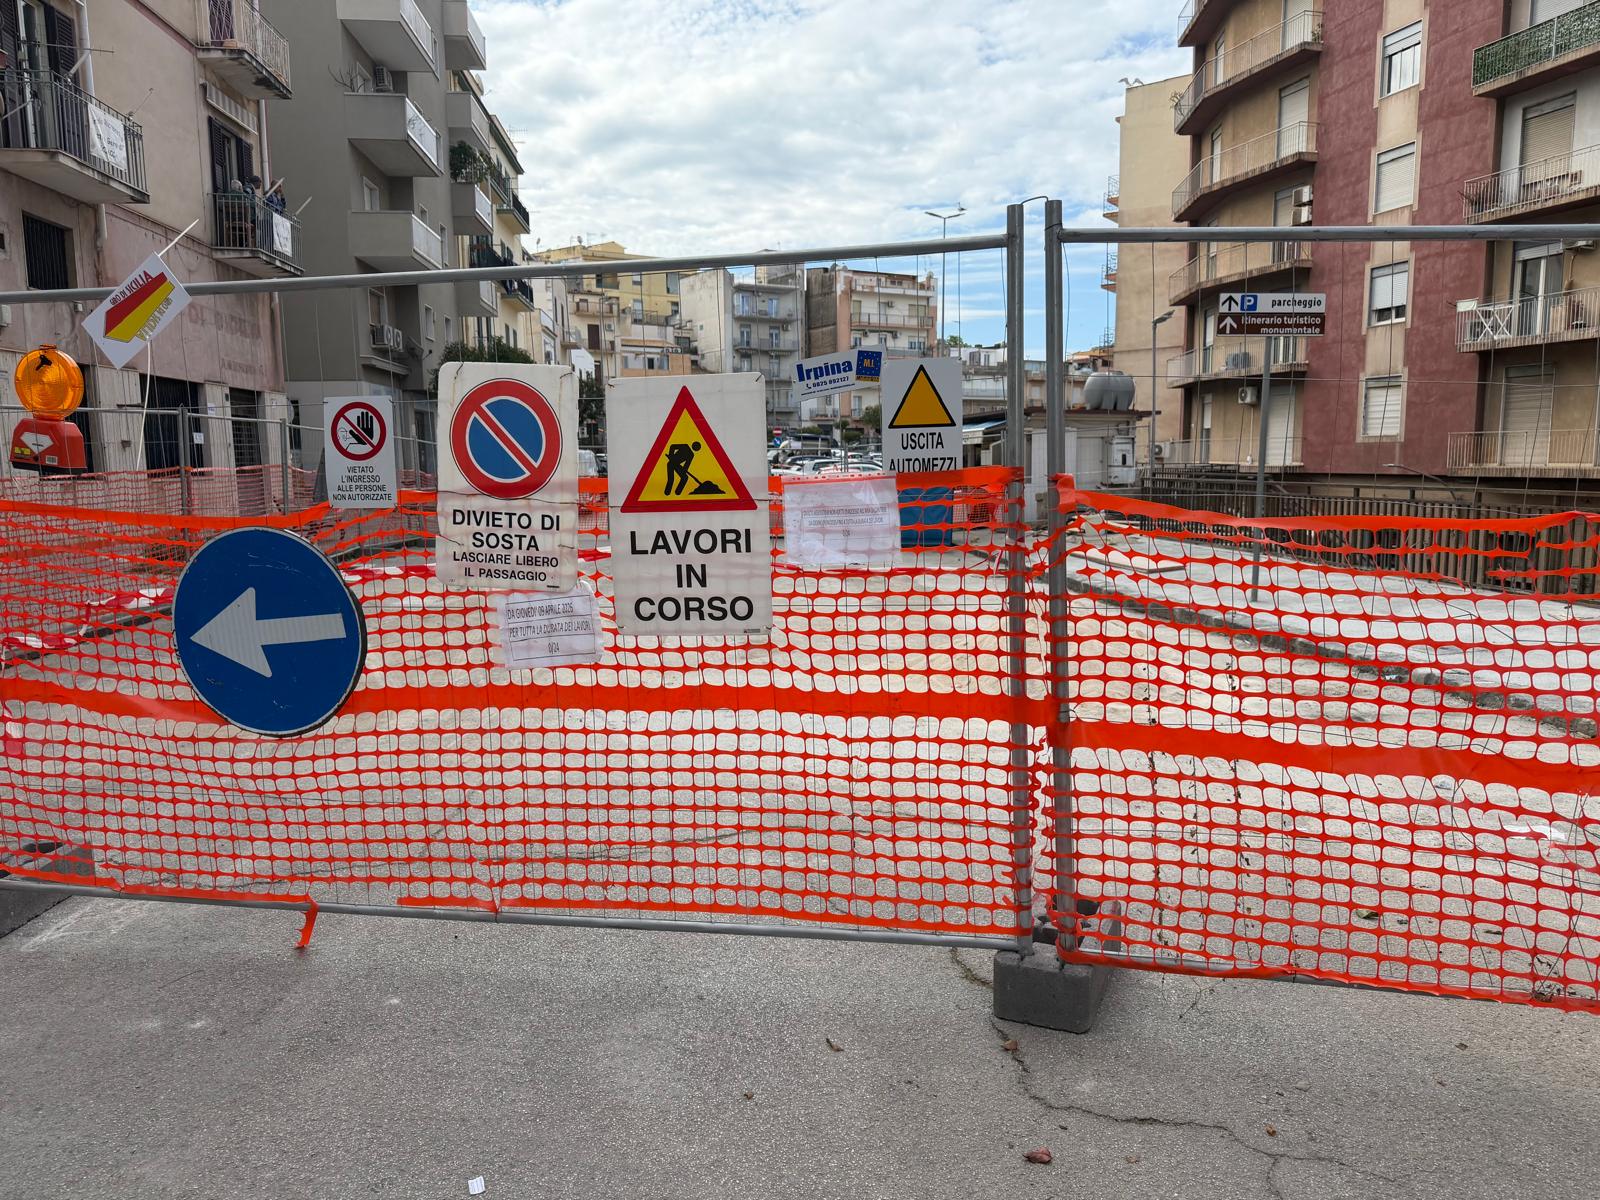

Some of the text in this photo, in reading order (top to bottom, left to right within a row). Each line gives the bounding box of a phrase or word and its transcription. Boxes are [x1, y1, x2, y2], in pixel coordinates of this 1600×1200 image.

[125, 270, 154, 293] SICILIA
[1271, 297, 1322, 308] parcheggio
[1283, 315, 1321, 325] turistico
[1260, 326, 1320, 334] monumentale
[796, 360, 853, 382] Irpina
[901, 432, 944, 450] USCITA
[347, 465, 374, 473] VIETATO
[889, 457, 957, 473] AUTOMEZZI
[341, 475, 381, 483] L'INGRESSO
[337, 484, 387, 492] ALLE PERSONE
[332, 493, 393, 501] NON AUTORIZZATE
[452, 509, 560, 531] DIVIETO DI
[472, 532, 540, 551] SOSTA
[630, 528, 752, 555] LAVORI
[453, 551, 559, 568] LASCIARE LIBERO
[464, 567, 547, 582] IL PASSAGGIO
[676, 563, 707, 588] IN
[634, 596, 754, 621] CORSO
